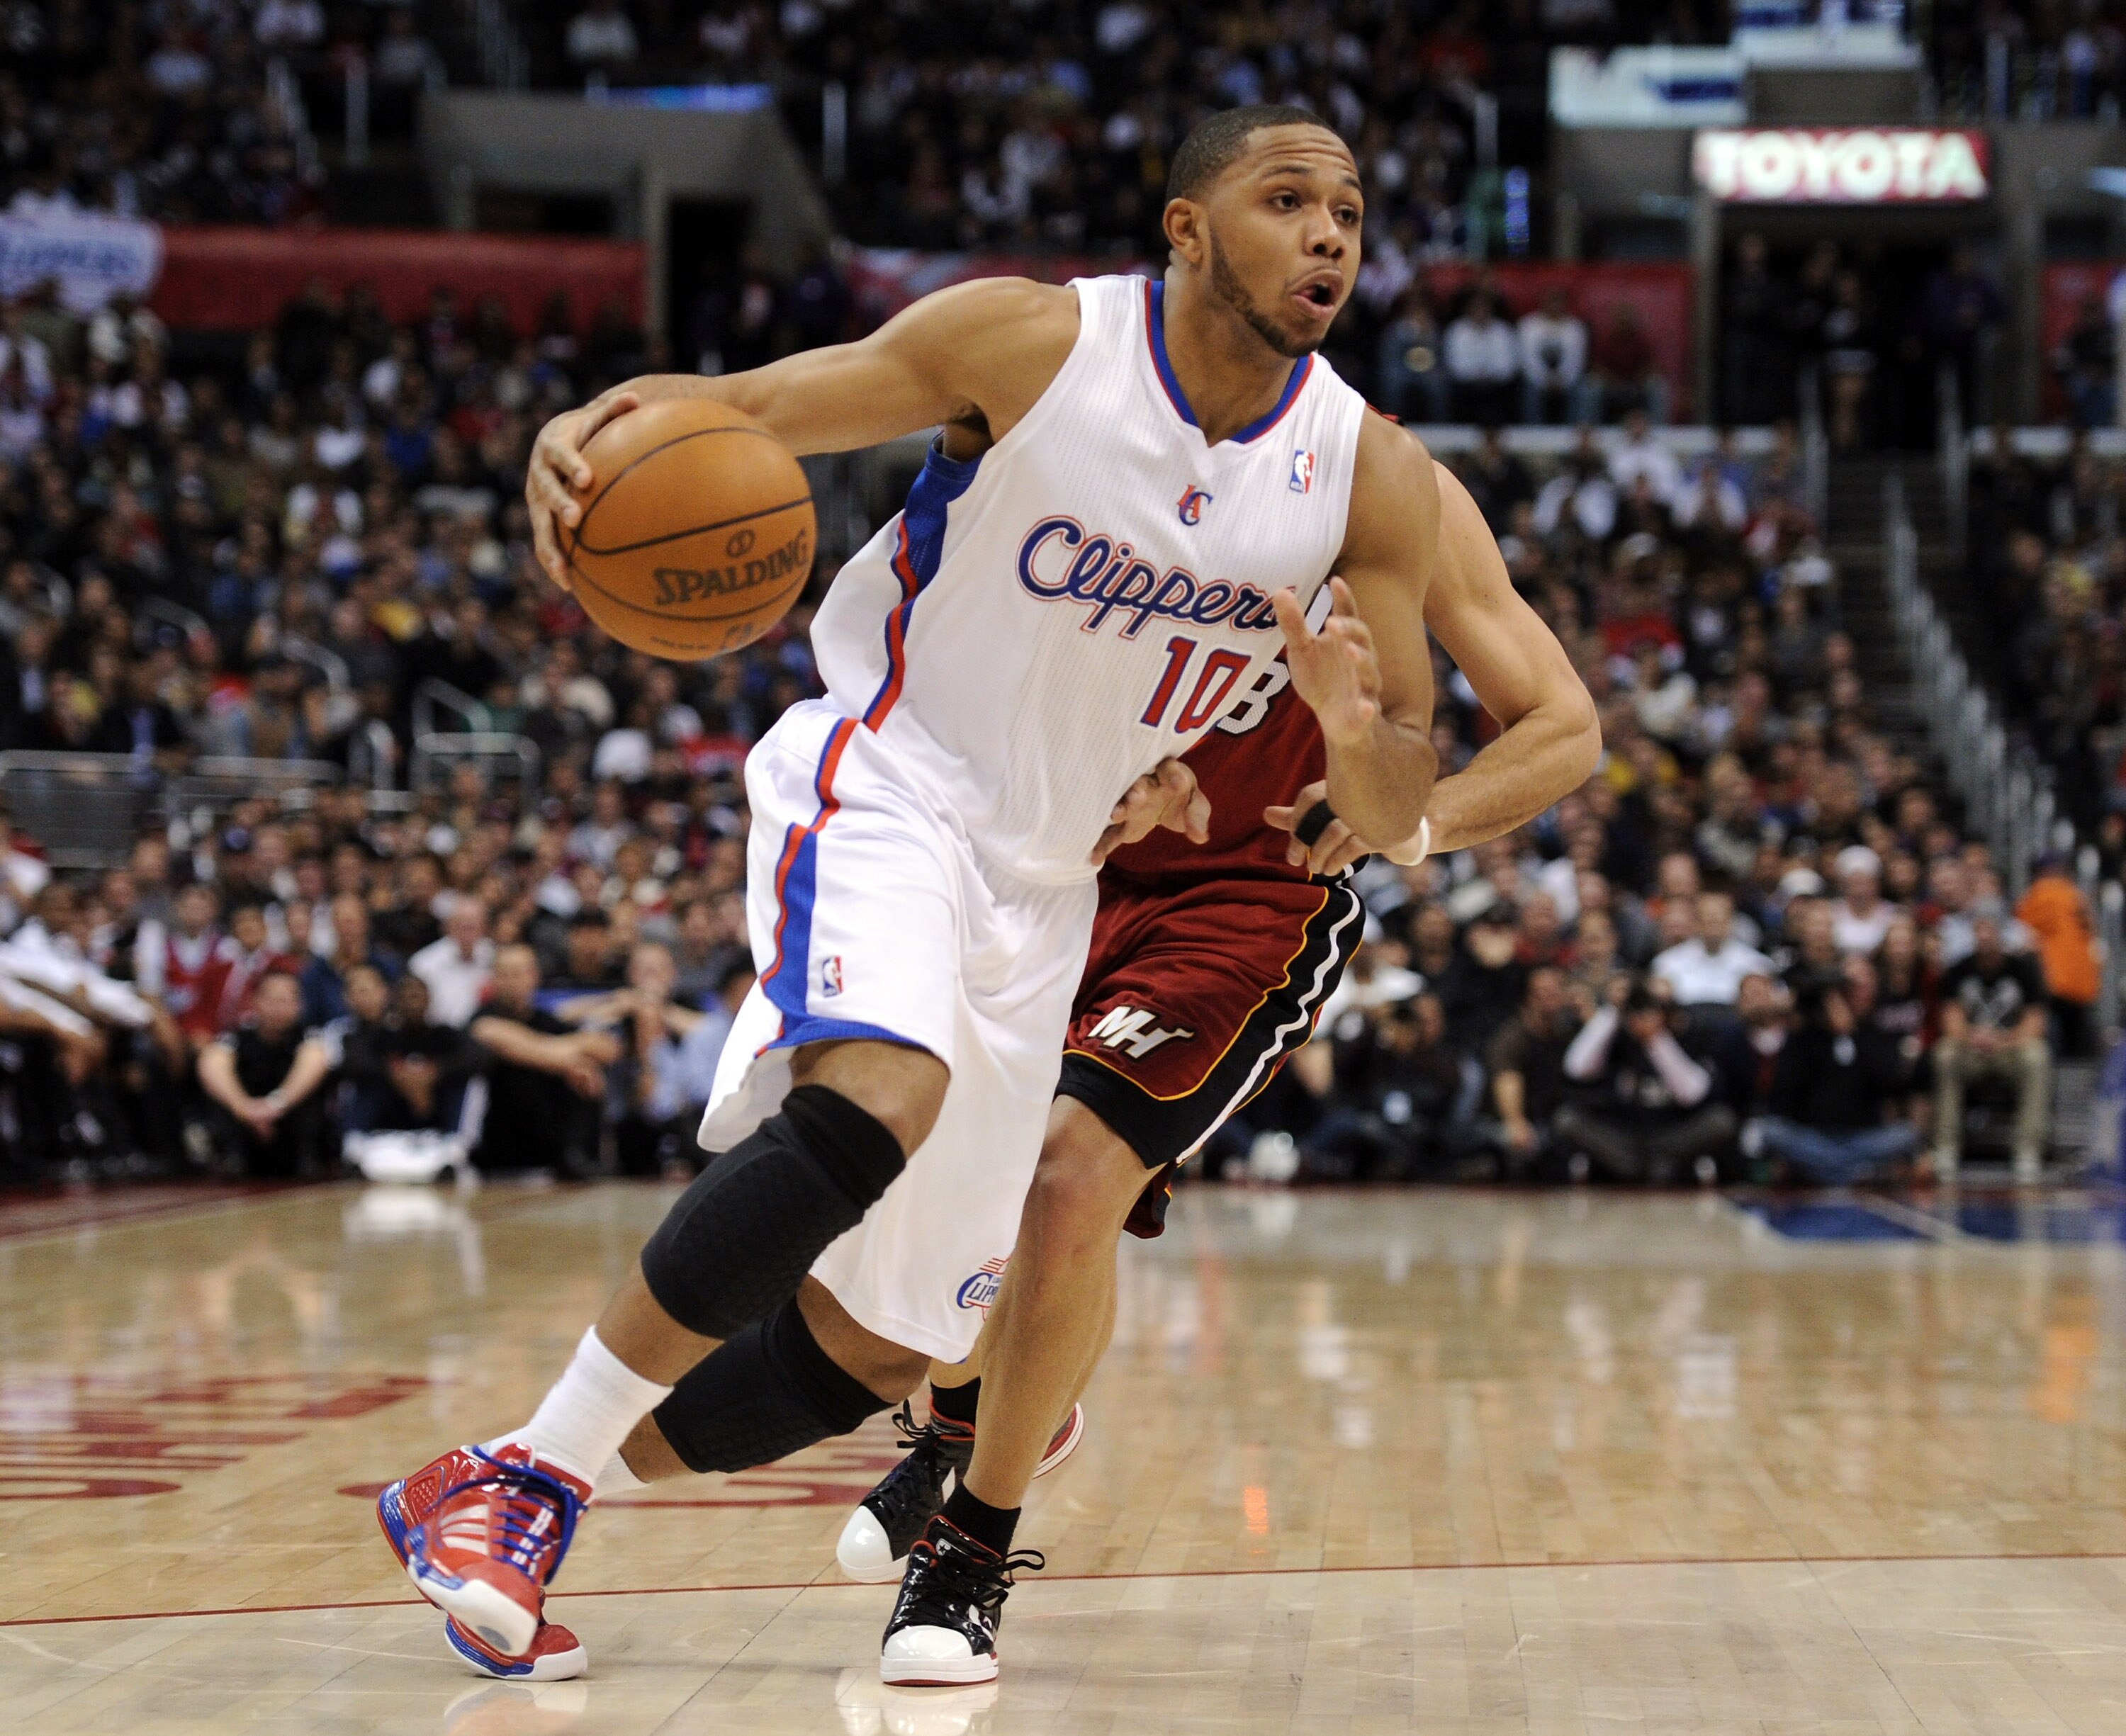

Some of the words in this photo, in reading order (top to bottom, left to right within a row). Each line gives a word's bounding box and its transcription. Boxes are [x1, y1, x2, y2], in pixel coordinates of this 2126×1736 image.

[1701, 130, 1986, 199] TOYOTA
[653, 528, 808, 606] SPALDING
[1140, 636, 1252, 734] 10
